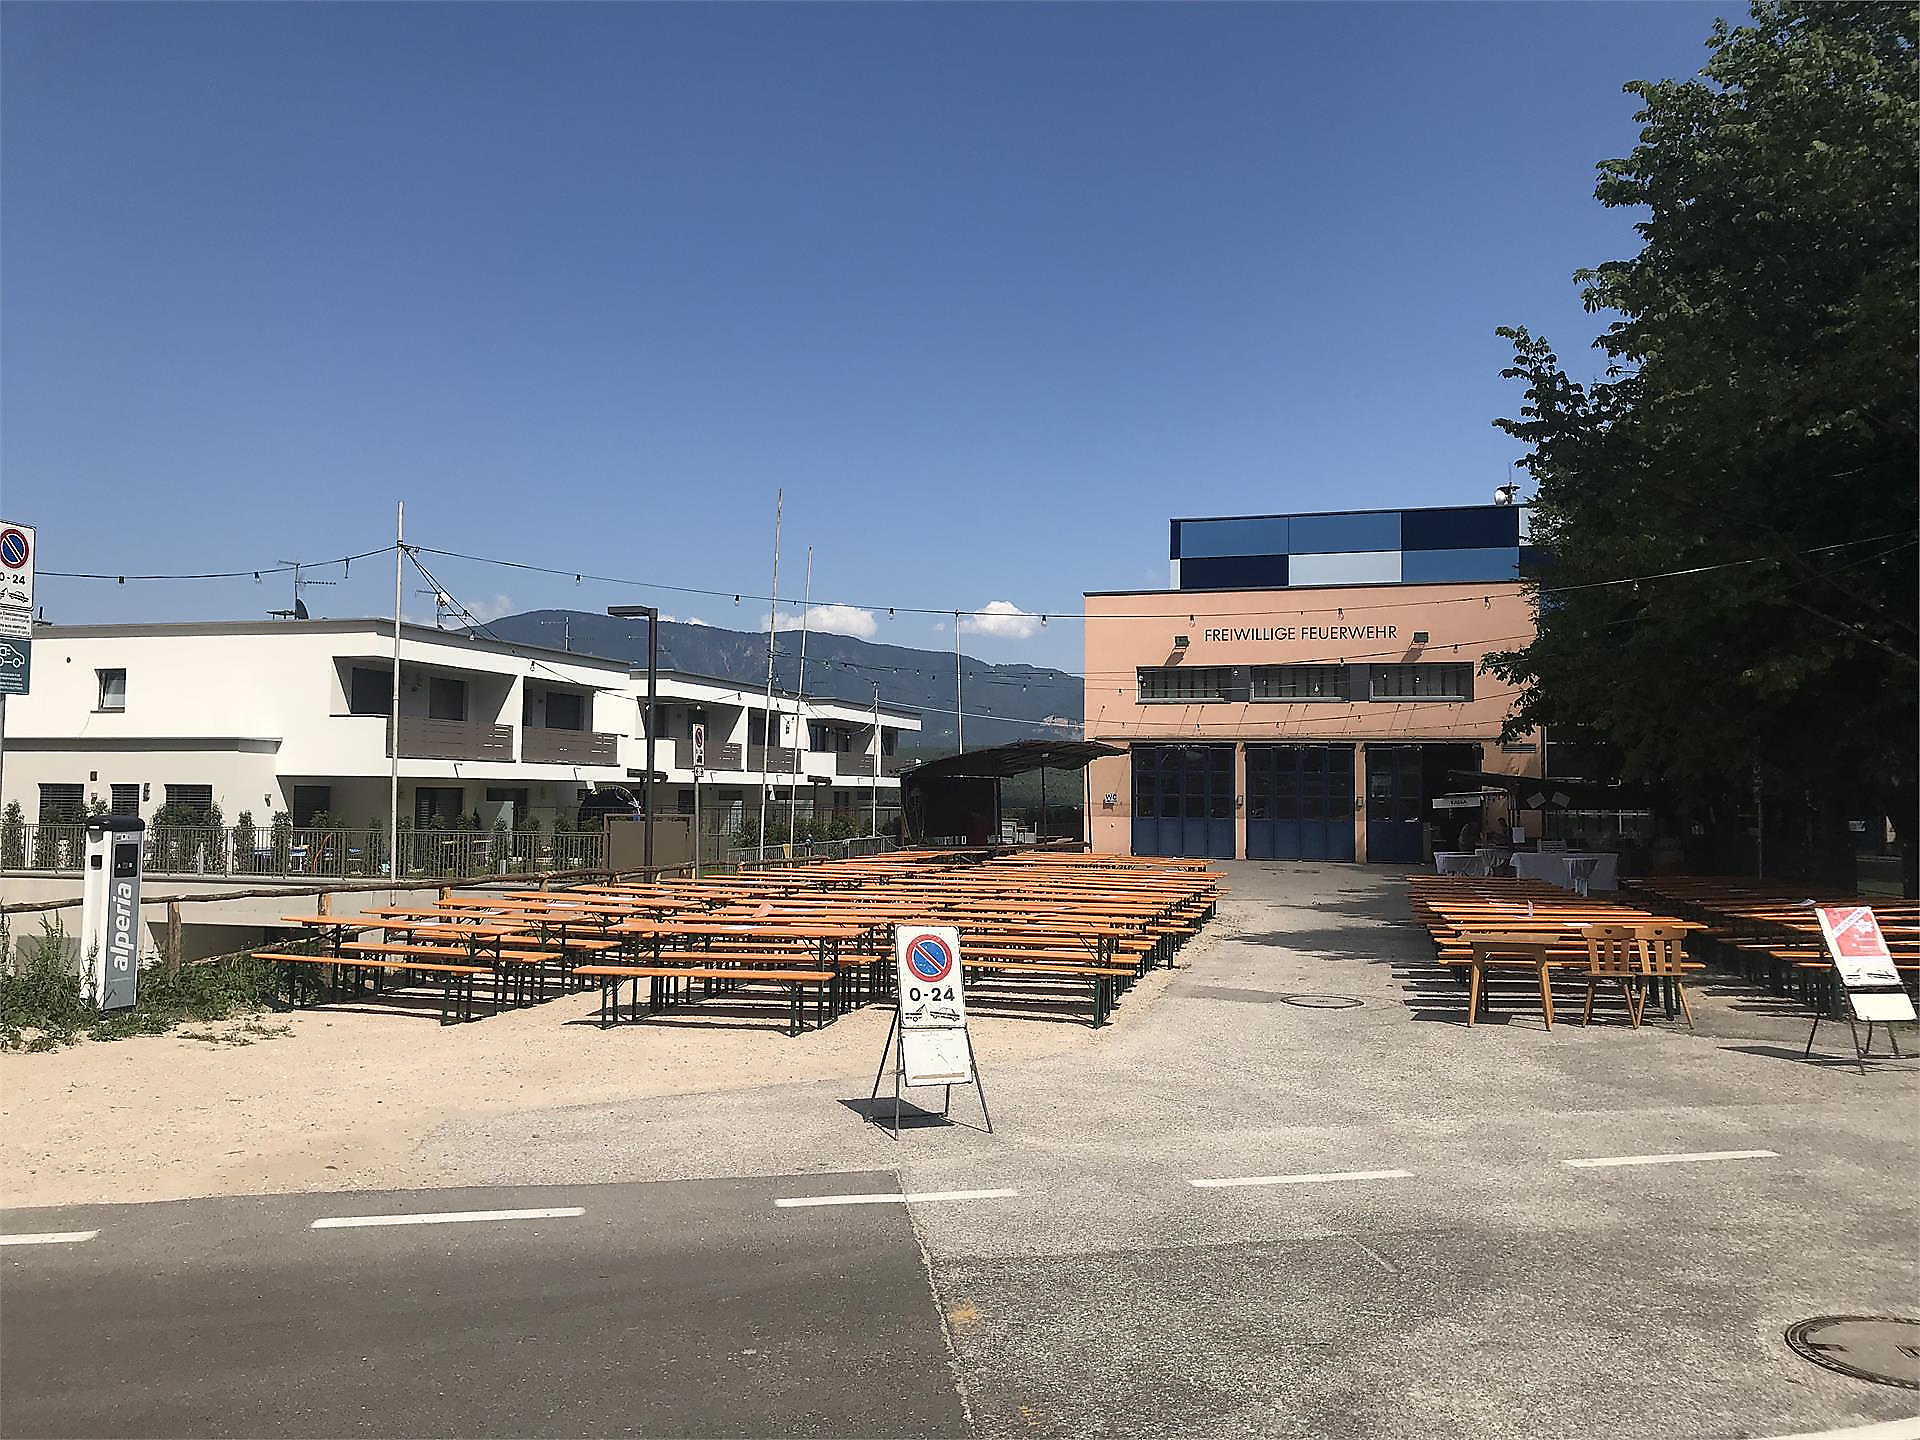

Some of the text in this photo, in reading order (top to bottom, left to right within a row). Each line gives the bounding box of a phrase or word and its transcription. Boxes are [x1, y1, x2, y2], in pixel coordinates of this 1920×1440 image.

[1204, 625, 1398, 642] FREIWILLIGE FEUERWEHR
[109, 882, 135, 972] alperia
